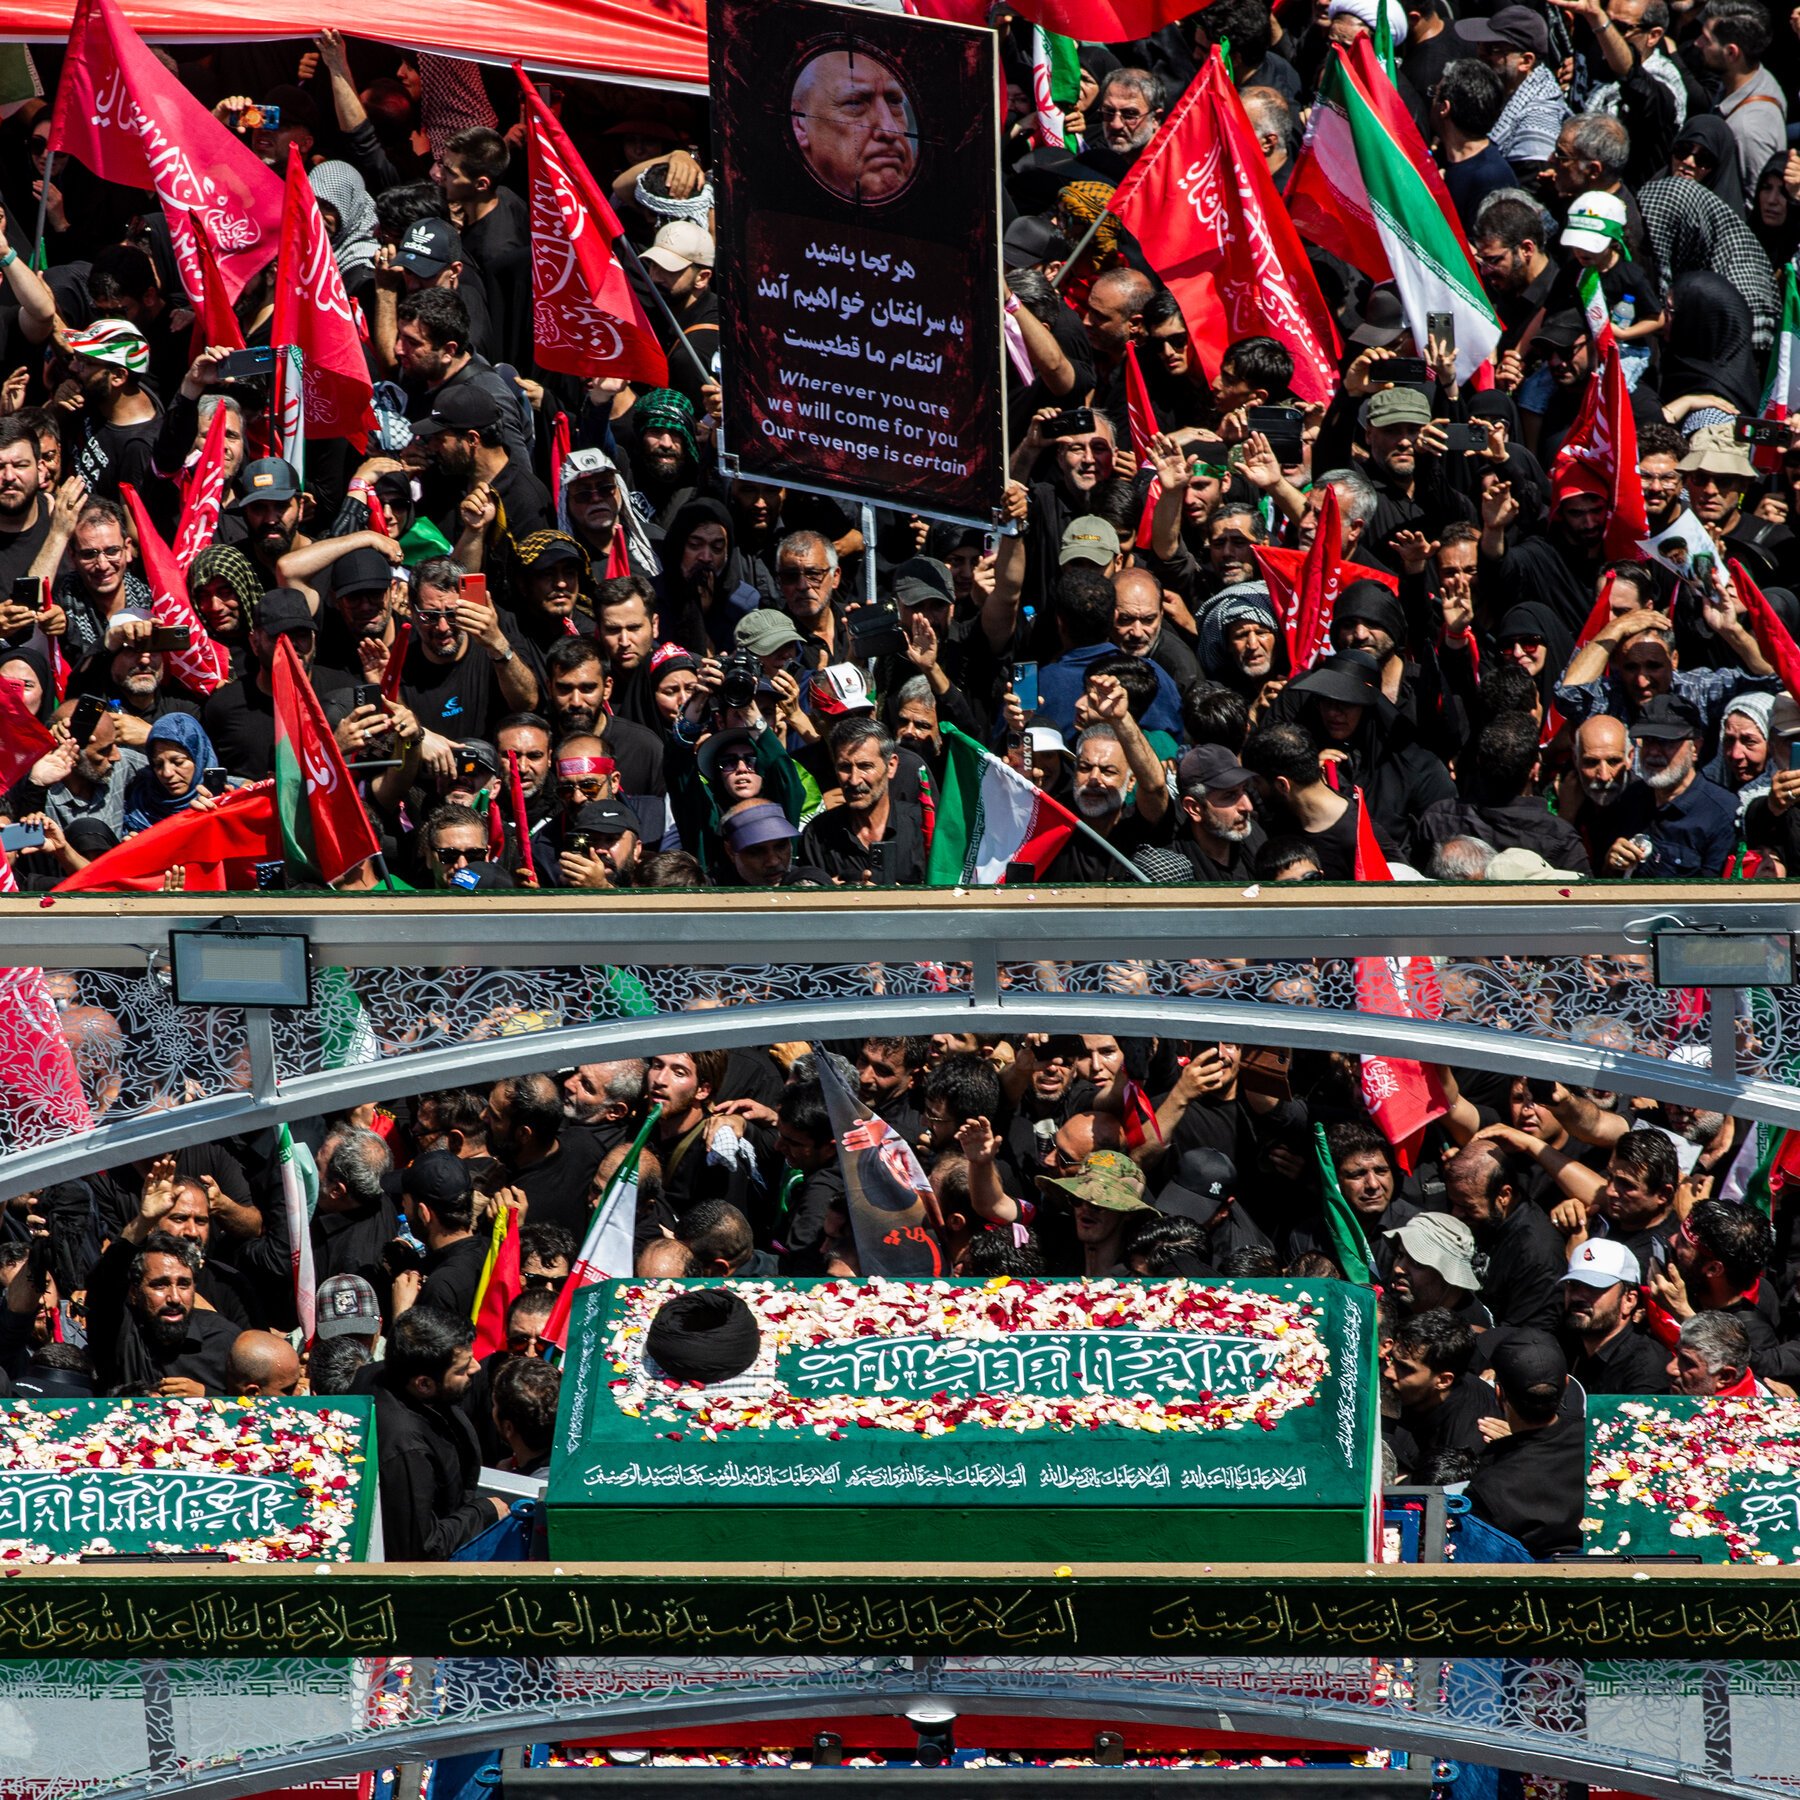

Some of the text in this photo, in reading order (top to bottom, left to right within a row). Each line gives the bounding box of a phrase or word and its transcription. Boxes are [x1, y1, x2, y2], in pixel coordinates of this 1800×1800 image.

[404, 242, 431, 255] adidas
[804, 242, 855, 272] باشید
[757, 273, 790, 299] آمد
[793, 286, 864, 320] خواهیم
[783, 328, 944, 375] انتقام ما قطعیست
[949, 315, 965, 341] به
[779, 368, 950, 418] Wherever you are
[767, 397, 958, 448] we will come for you
[761, 418, 968, 477] Our revenge is certain
[1023, 736, 1032, 771] TOKYO
[220, 1598, 311, 1651] عليك
[291, 1596, 398, 1651] السلام
[449, 1591, 595, 1649] العالمين
[600, 1599, 664, 1645] نساء
[665, 1599, 757, 1646] سيدة
[751, 1594, 842, 1645] فاطمة
[866, 1597, 966, 1646] عليك
[949, 1589, 1078, 1645] السلام
[1149, 1593, 1293, 1646] الوصيين
[1406, 1591, 1549, 1646] المؤمنين
[1649, 1602, 1737, 1646] عليك
[1726, 1599, 1800, 1645] لسلام
